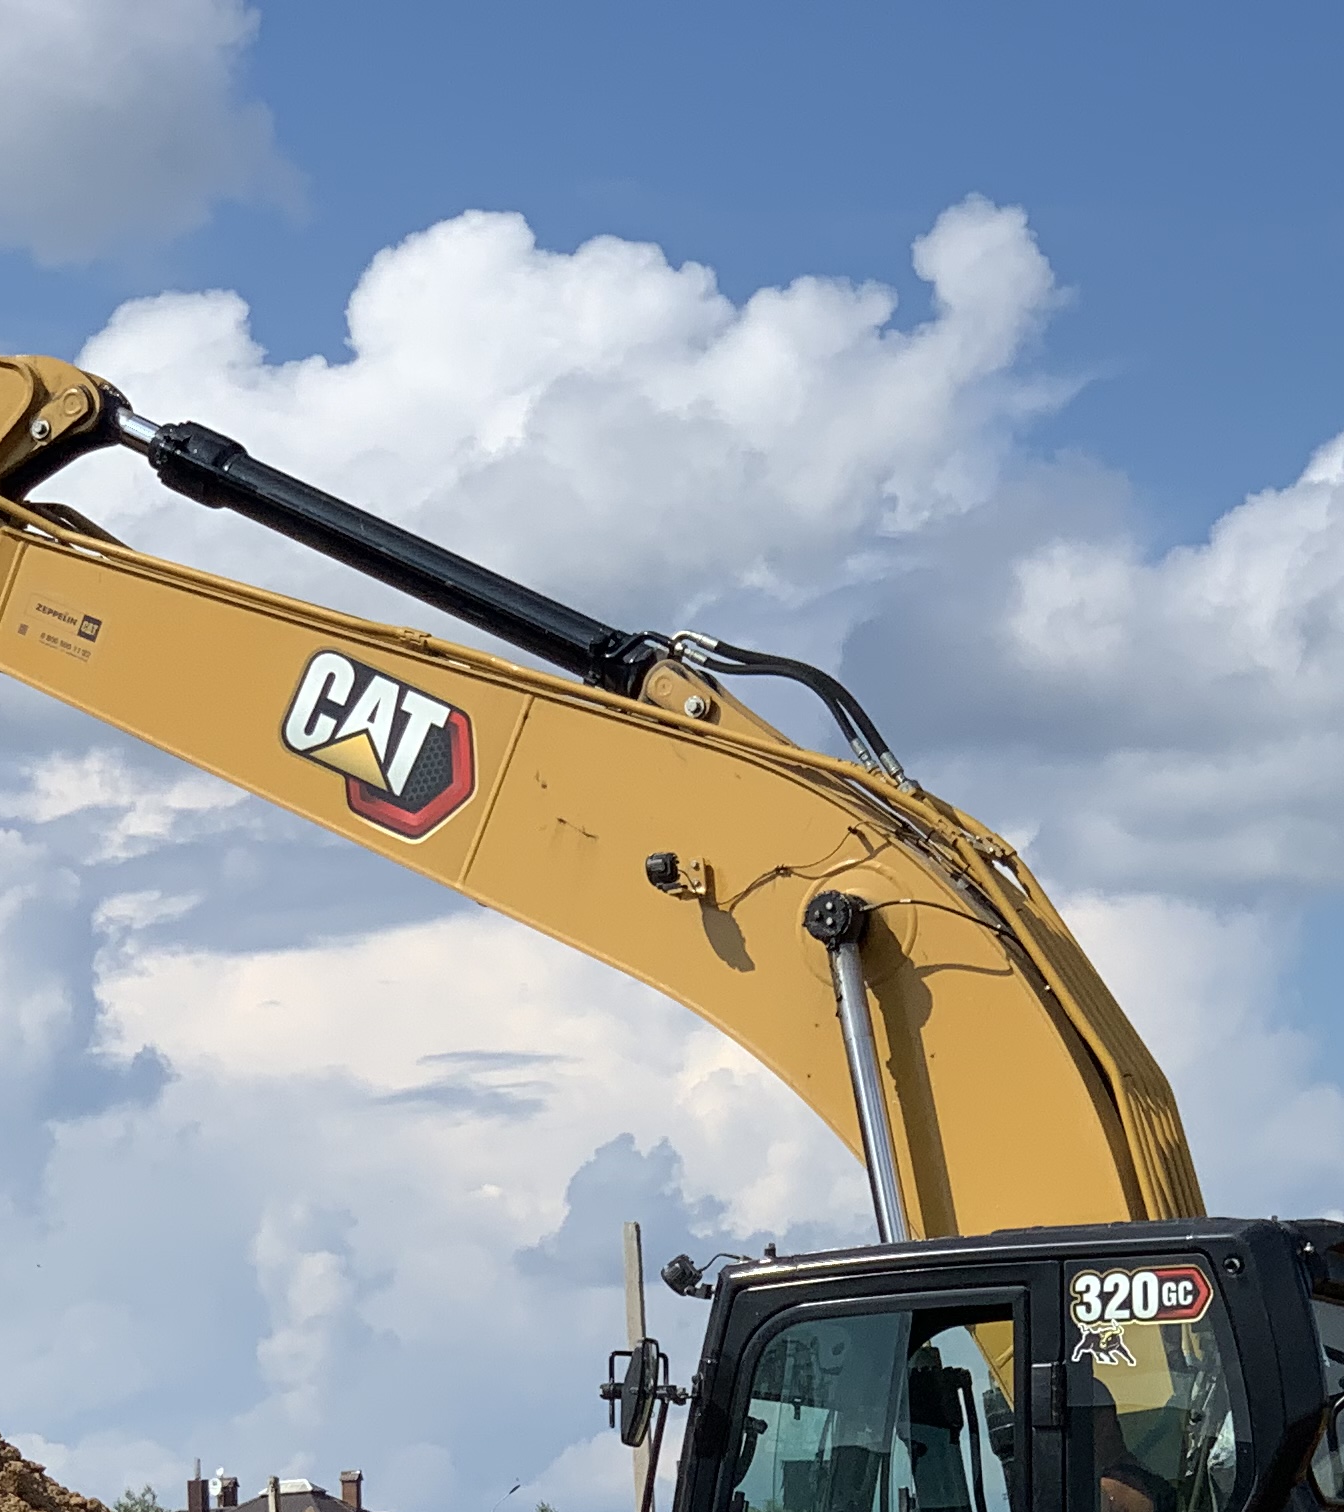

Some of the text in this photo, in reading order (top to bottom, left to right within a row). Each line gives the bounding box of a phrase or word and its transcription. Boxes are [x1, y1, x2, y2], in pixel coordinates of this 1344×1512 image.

[35, 603, 78, 626] ZEPPELIN
[285, 652, 452, 797] CAT
[1075, 1271, 1194, 1322] 320 GC
